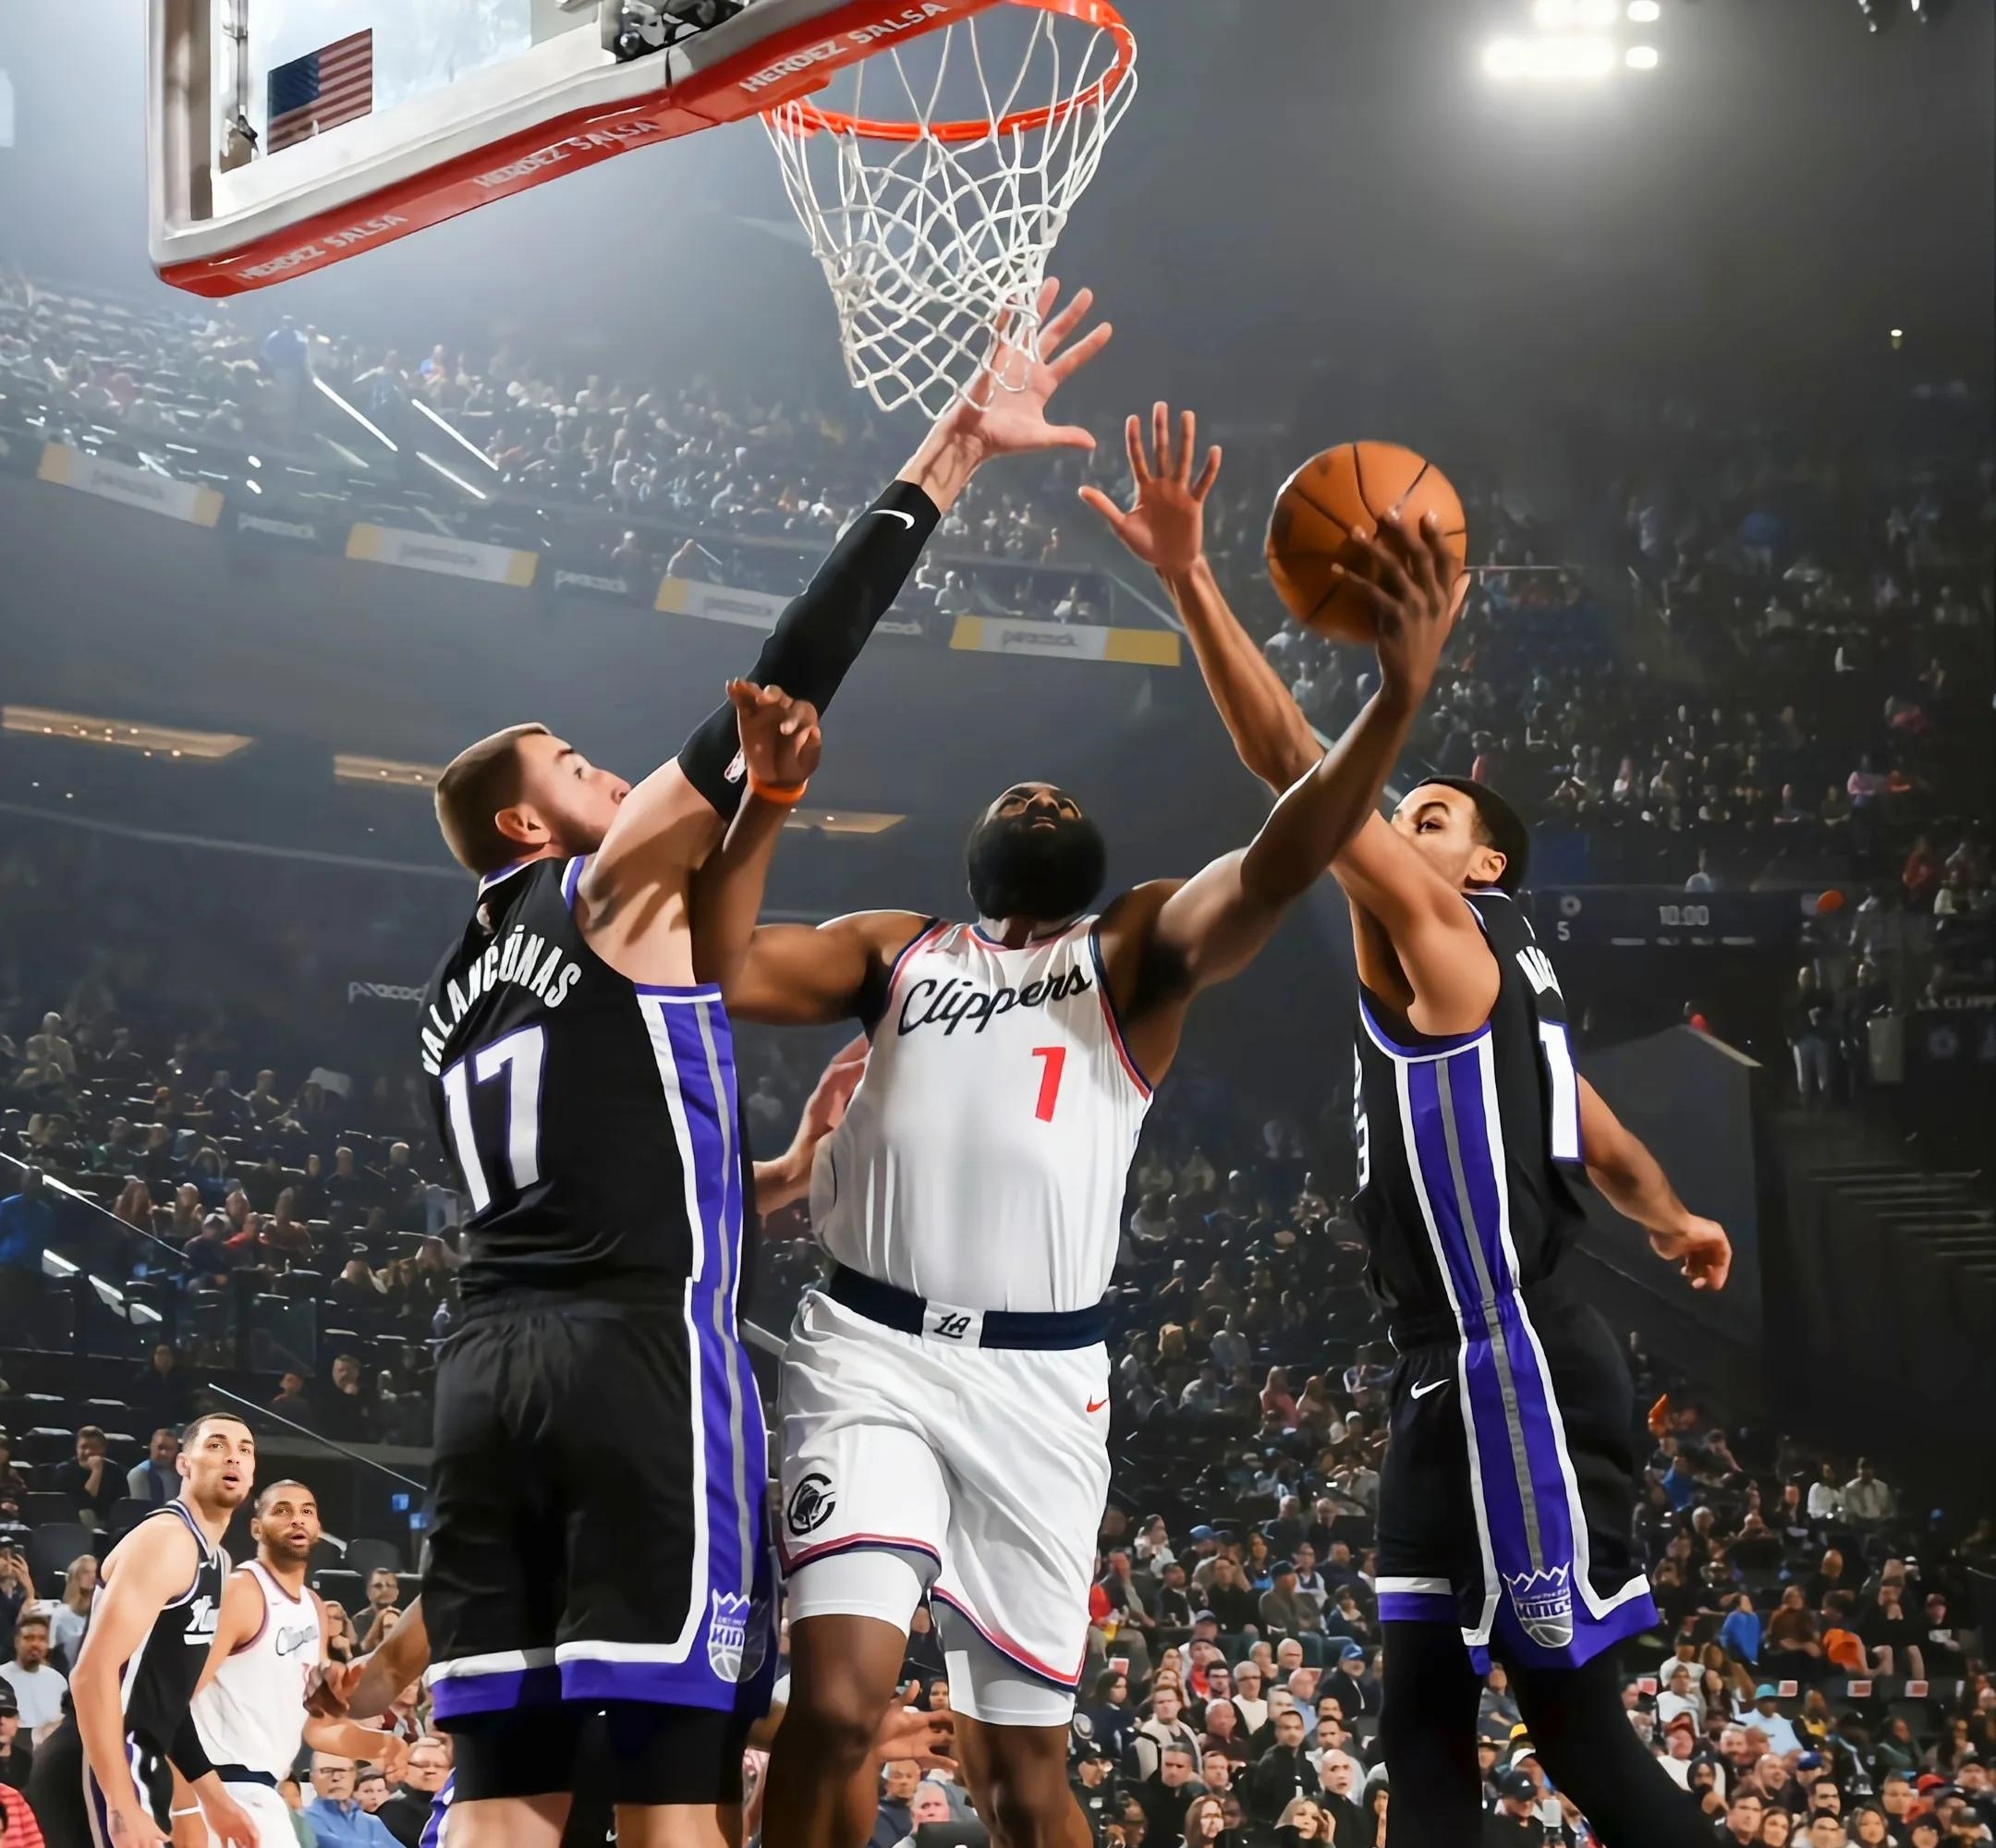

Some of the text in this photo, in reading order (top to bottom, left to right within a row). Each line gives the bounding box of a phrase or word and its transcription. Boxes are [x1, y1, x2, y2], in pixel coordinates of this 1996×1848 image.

[847, 3, 950, 44] SALSA
[322, 214, 408, 249] SALSA
[1556, 921, 1571, 942] 5
[897, 964, 1093, 1037] Clippers
[1031, 1046, 1066, 1124] 1
[438, 1022, 547, 1215] 17
